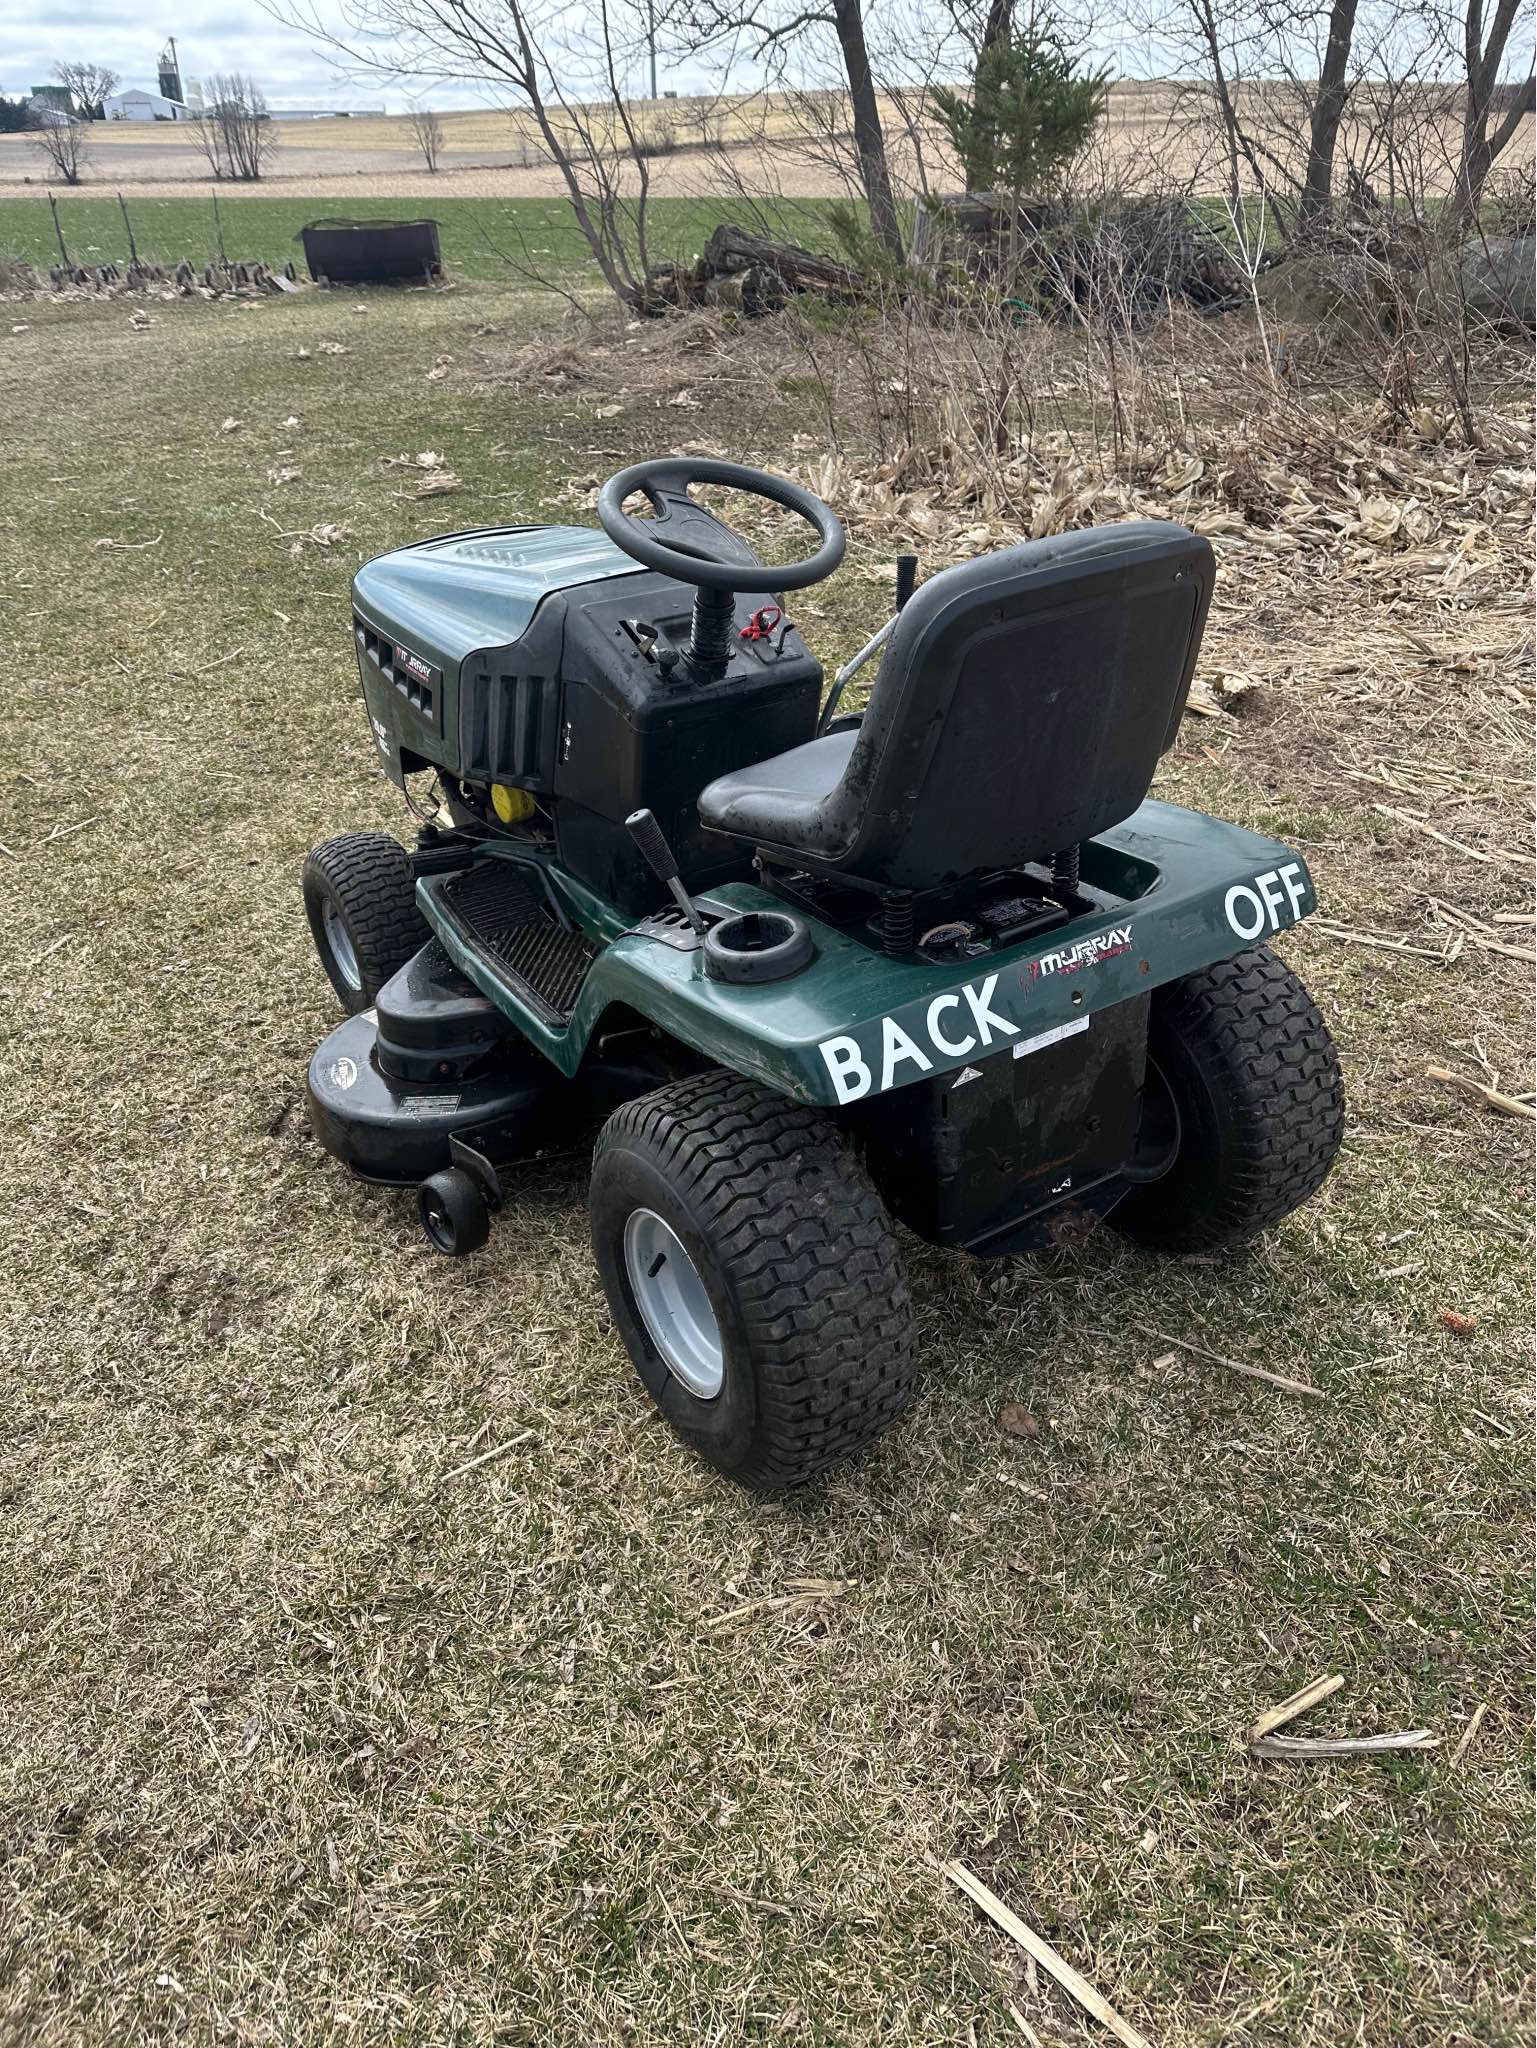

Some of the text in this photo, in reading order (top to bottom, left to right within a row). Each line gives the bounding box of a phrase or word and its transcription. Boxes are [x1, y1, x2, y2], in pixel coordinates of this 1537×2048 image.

[819, 862, 1305, 1105] BACK OFF
[1040, 925, 1132, 976] MURRAY
